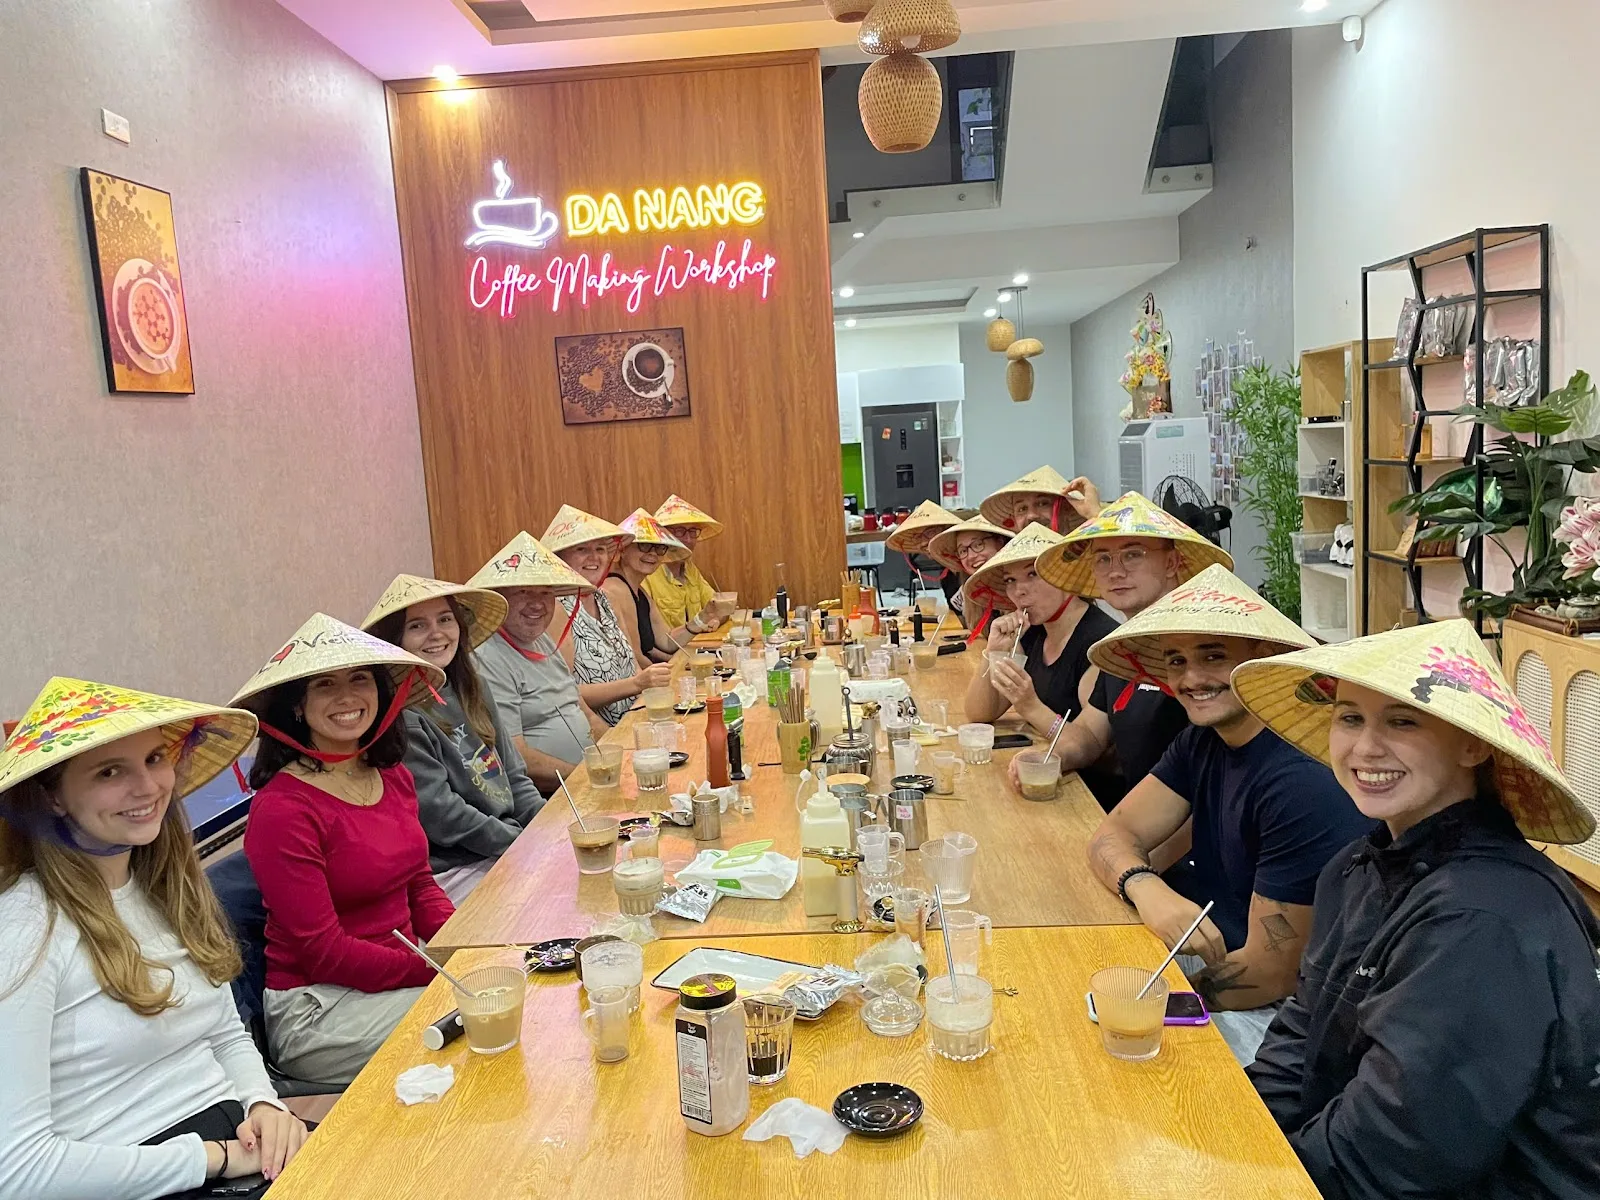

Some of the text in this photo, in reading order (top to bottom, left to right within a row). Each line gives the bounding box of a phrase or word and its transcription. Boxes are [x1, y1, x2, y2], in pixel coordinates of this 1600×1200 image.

[566, 181, 766, 237] DA NANG
[470, 239, 777, 317] Coffee Making Workshop
